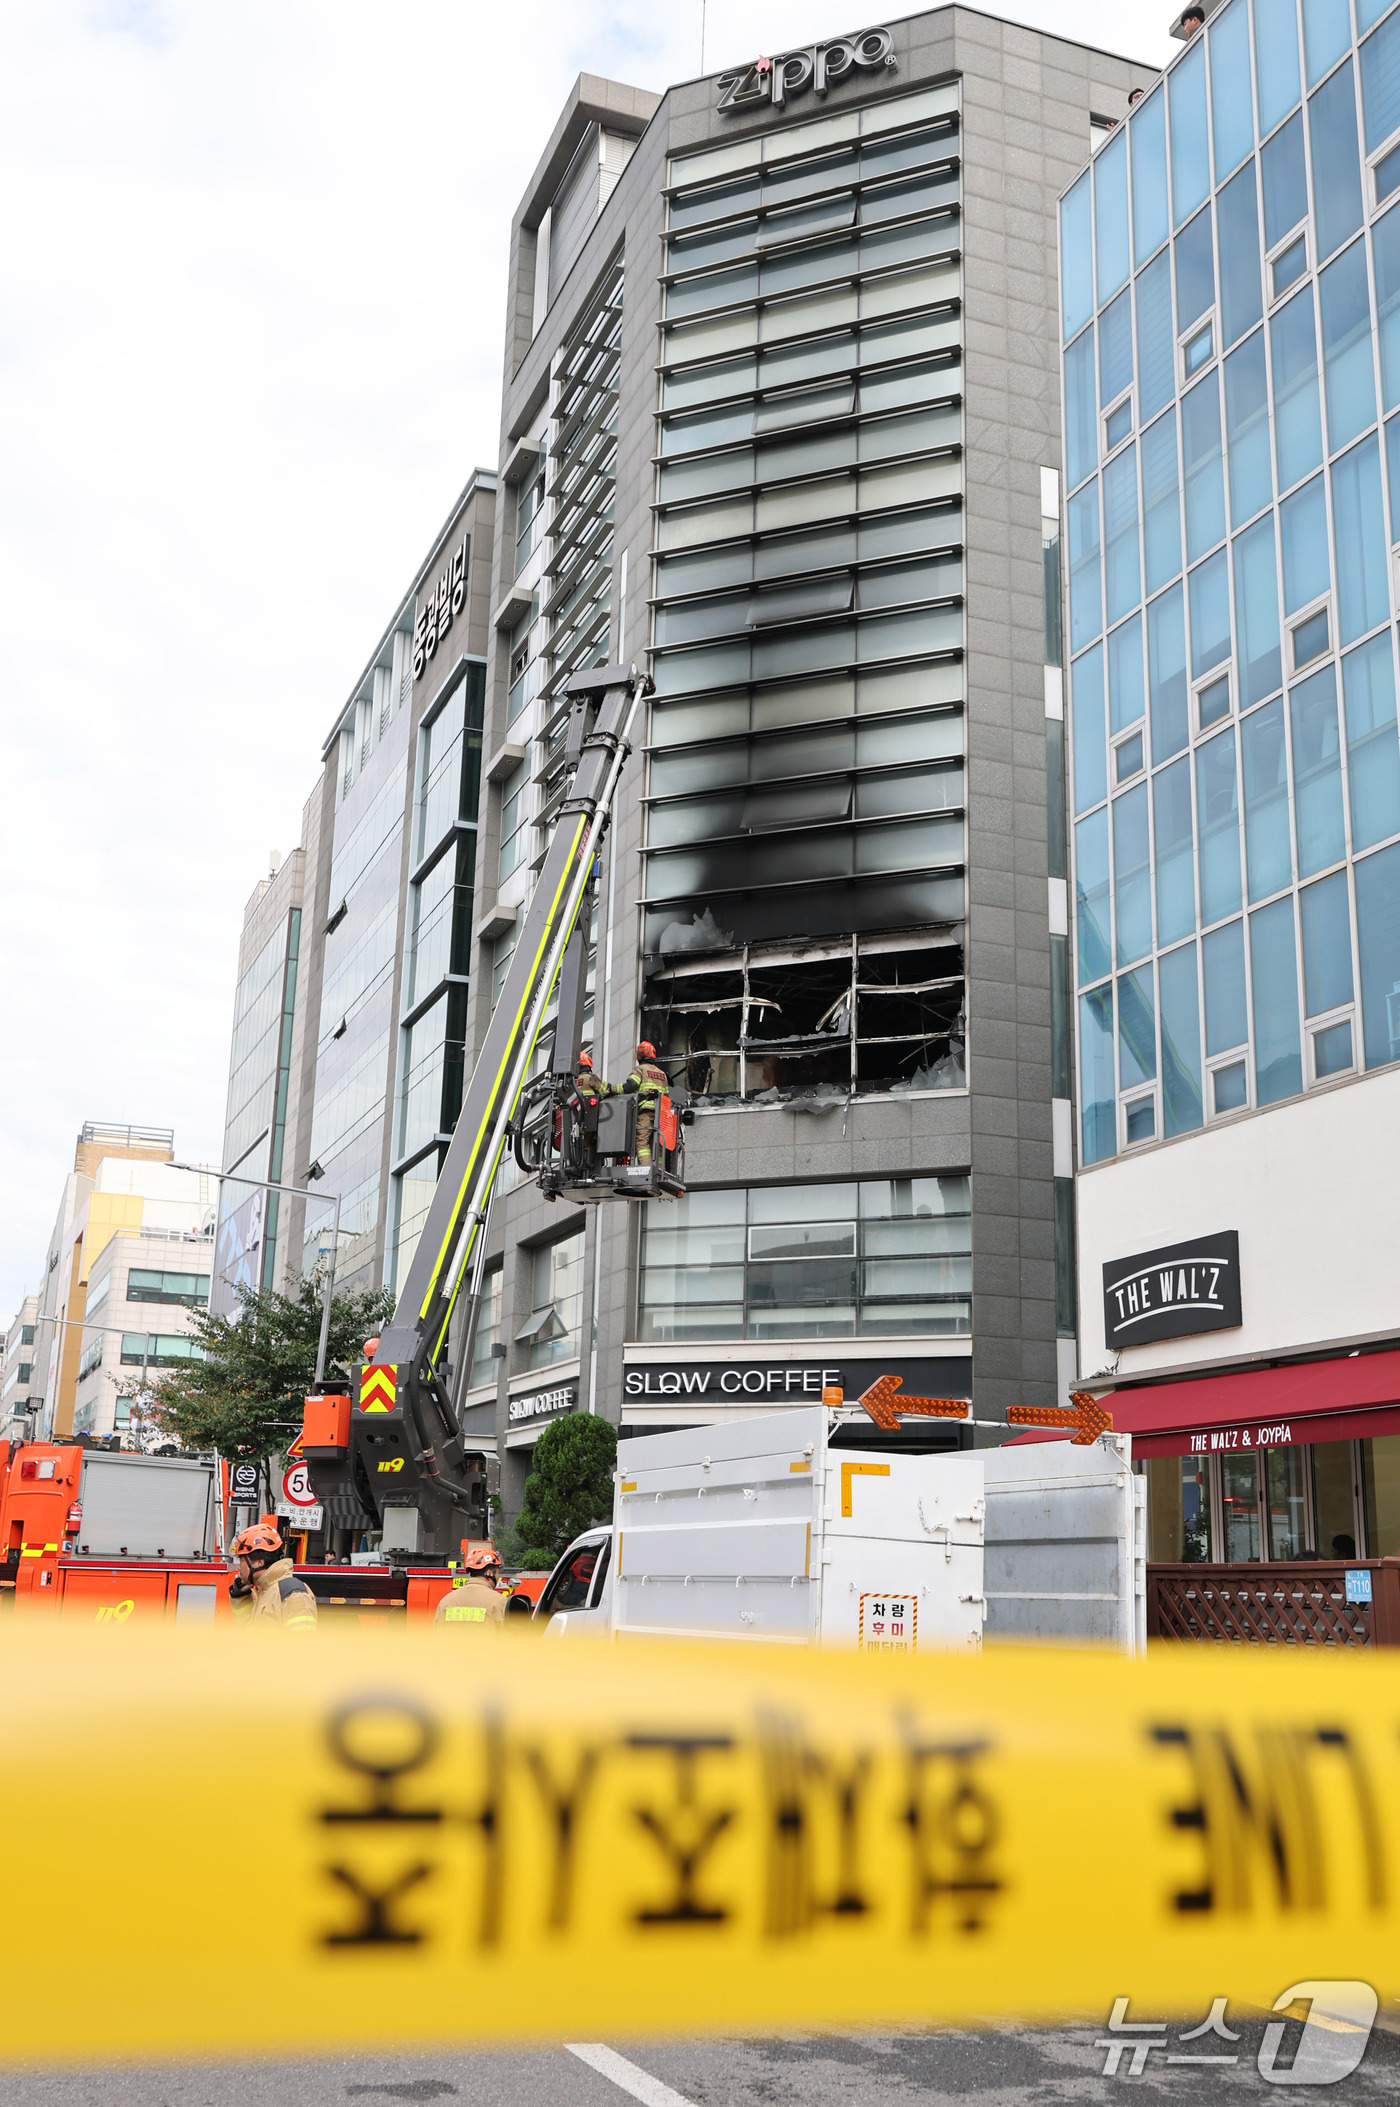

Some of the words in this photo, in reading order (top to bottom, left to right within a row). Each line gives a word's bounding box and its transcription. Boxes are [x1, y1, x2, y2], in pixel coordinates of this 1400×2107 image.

[413, 533, 471, 681] 동광빌딩
[1115, 1277, 1151, 1319] THE
[1159, 1266, 1220, 1303] WAL'Z
[625, 1371, 711, 1394] SLOW
[720, 1369, 840, 1393] COFFEE
[509, 1396, 536, 1420] SLOW
[535, 1386, 573, 1414] COFFEE
[1190, 1434, 1208, 1452] THE
[1211, 1430, 1238, 1450] WAL'Z
[1242, 1429, 1252, 1446] &
[377, 1457, 405, 1473] 119
[1352, 1579, 1370, 1594] T110
[94, 1599, 135, 1624] 119
[873, 1603, 904, 1618] 차량
[872, 1621, 904, 1637] 후미
